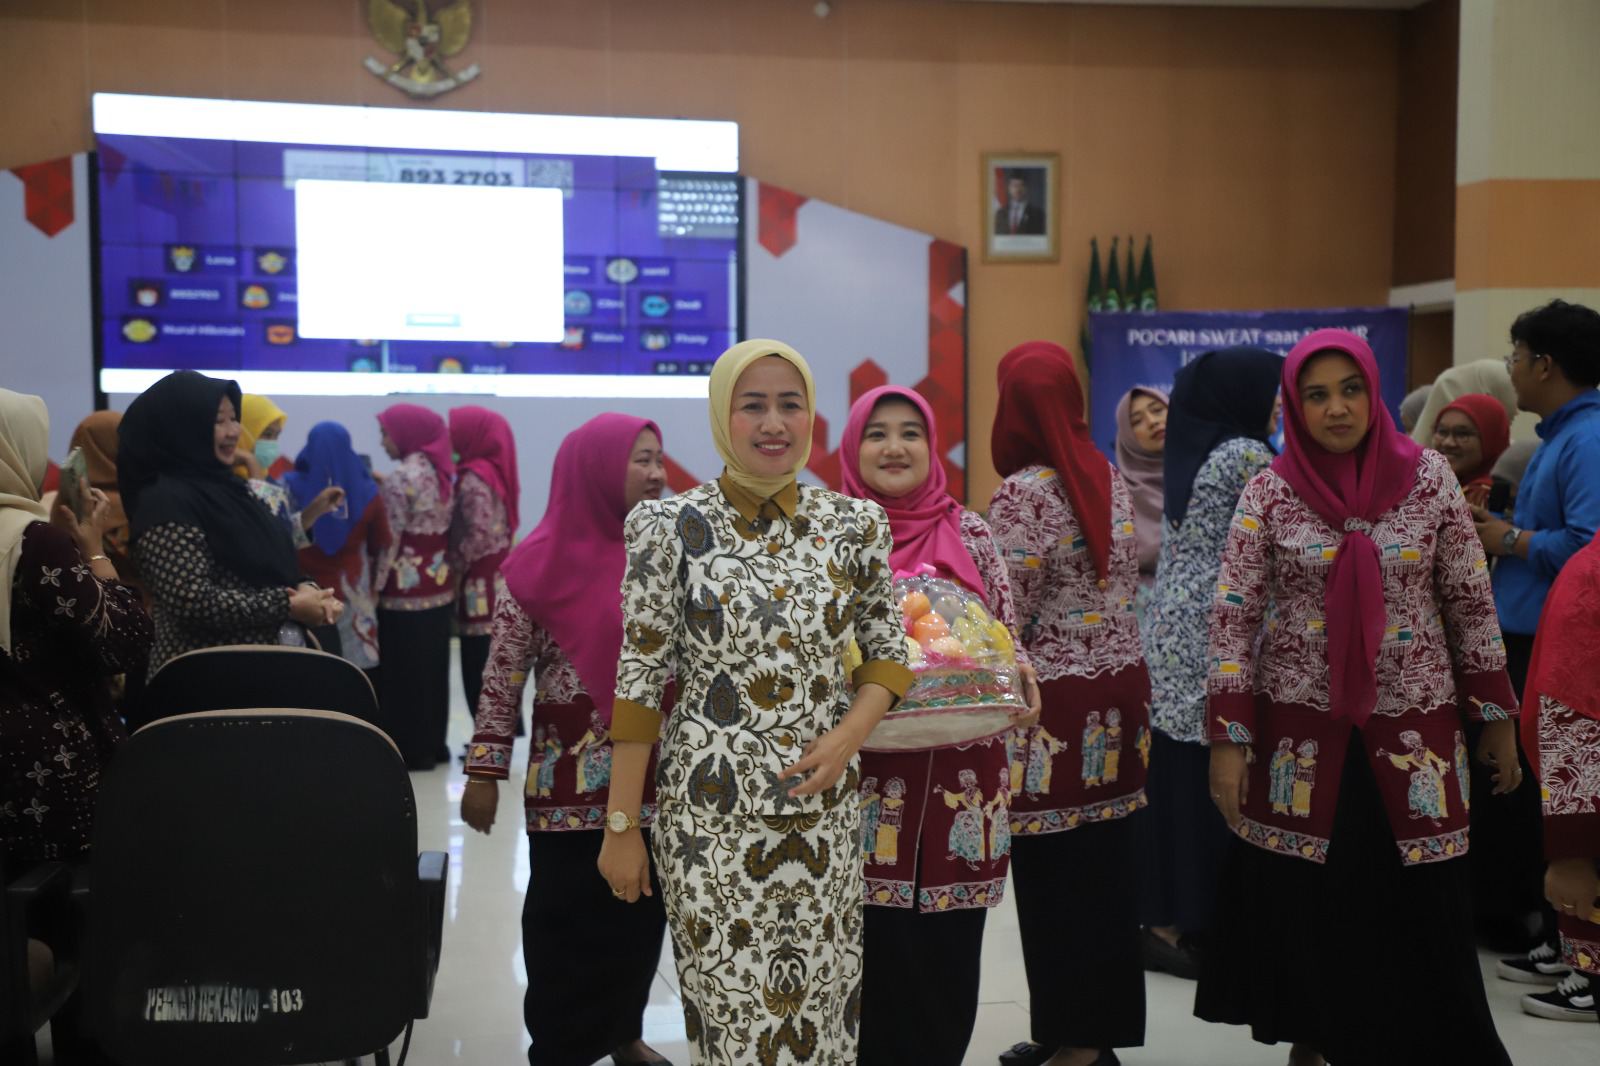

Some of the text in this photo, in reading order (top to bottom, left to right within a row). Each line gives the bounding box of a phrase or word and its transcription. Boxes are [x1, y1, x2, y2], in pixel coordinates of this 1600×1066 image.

[400, 168, 447, 184] 893
[452, 169, 514, 187] 2703
[1128, 328, 1196, 345] POCARI
[1199, 328, 1261, 345] SWEAT
[1264, 330, 1299, 344] saat
